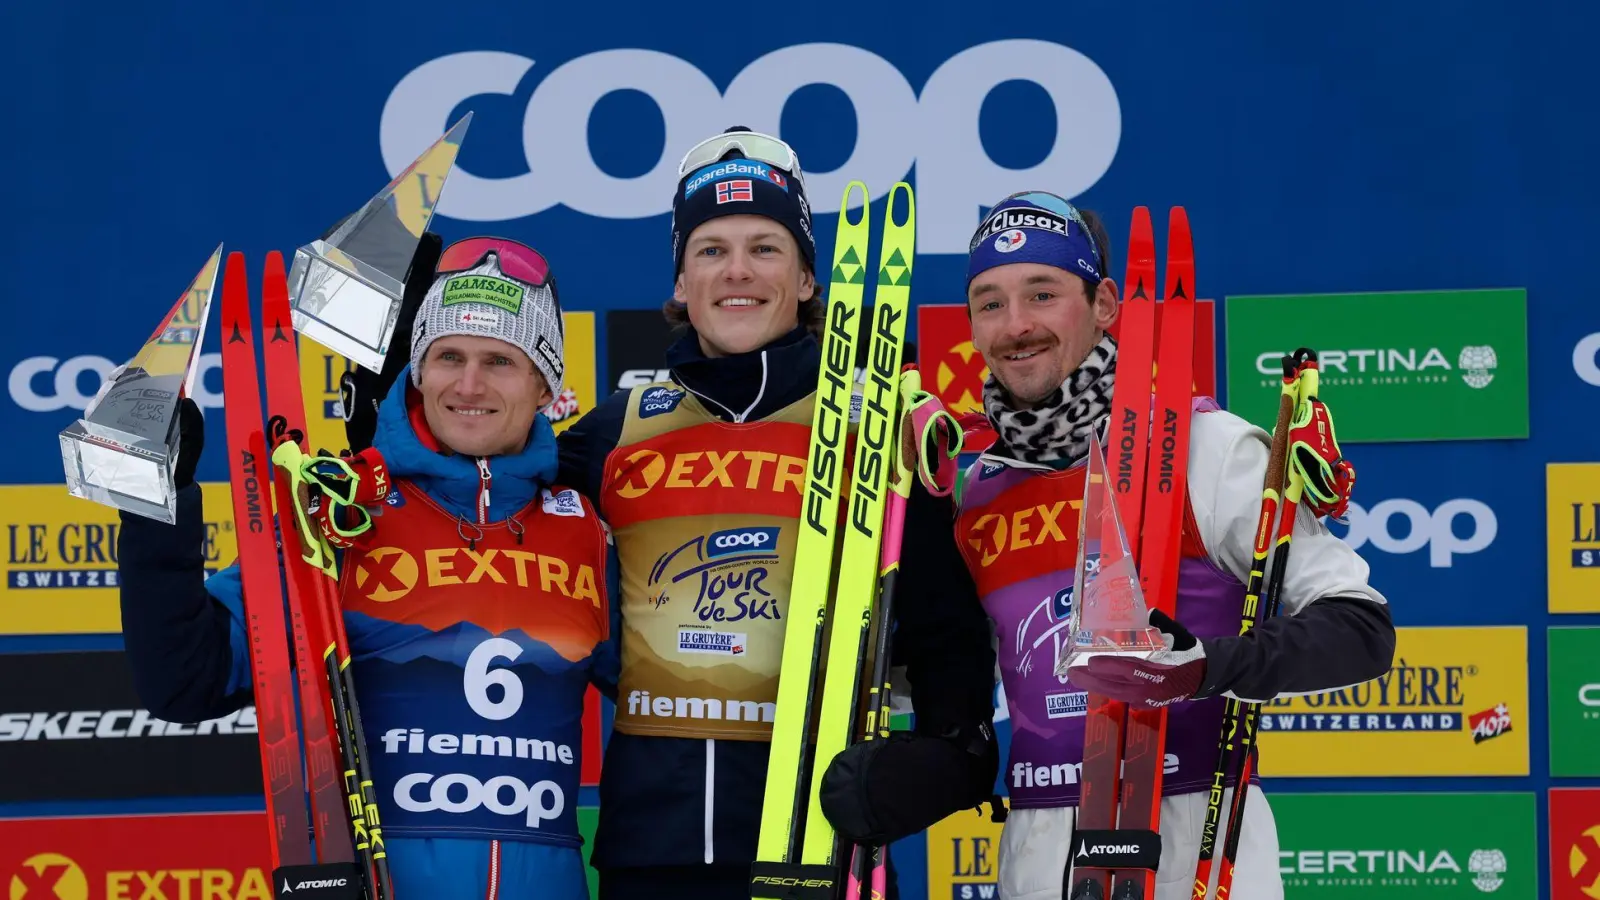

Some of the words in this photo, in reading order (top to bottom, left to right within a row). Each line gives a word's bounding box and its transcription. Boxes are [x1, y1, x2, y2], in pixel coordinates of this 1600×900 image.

[380, 39, 1122, 253] coop
[686, 163, 766, 194] SpareBank
[991, 211, 1065, 233] Clusaz
[445, 293, 481, 302] SCHLADMING
[485, 295, 518, 310] DACHSTEIN
[448, 279, 519, 298] RAMSAU
[1256, 348, 1451, 375] CRTINA
[807, 300, 855, 536] FISCHER
[852, 303, 902, 538] FISCHER
[1315, 407, 1329, 453] LEKI
[1117, 408, 1136, 493] ATOMIC
[1158, 408, 1177, 493] ATOMIC
[243, 450, 263, 533] ATOMIC
[665, 450, 812, 496] EXTR
[8, 524, 48, 564] LE
[715, 532, 769, 548] coop
[1010, 500, 1085, 551] EXT
[1325, 499, 1498, 568] oop
[425, 547, 600, 608] EXTRA
[1239, 570, 1263, 636] LEK
[680, 633, 690, 642] LE
[463, 638, 524, 721] 6
[627, 690, 776, 722] fiemm
[1261, 713, 1454, 731] SWITZERLAND
[381, 728, 573, 765] fiemme
[344, 769, 369, 850] LEKI
[360, 780, 386, 859] LEKI
[393, 773, 565, 828] coop
[951, 837, 991, 877] LE
[1090, 844, 1140, 854] ATOMIC
[106, 868, 272, 900] EXTRA
[296, 878, 347, 890] ATOMIC
[752, 876, 833, 888] FISCHER
[1317, 878, 1373, 886] WATCHES
[1381, 878, 1418, 886] SINCE
